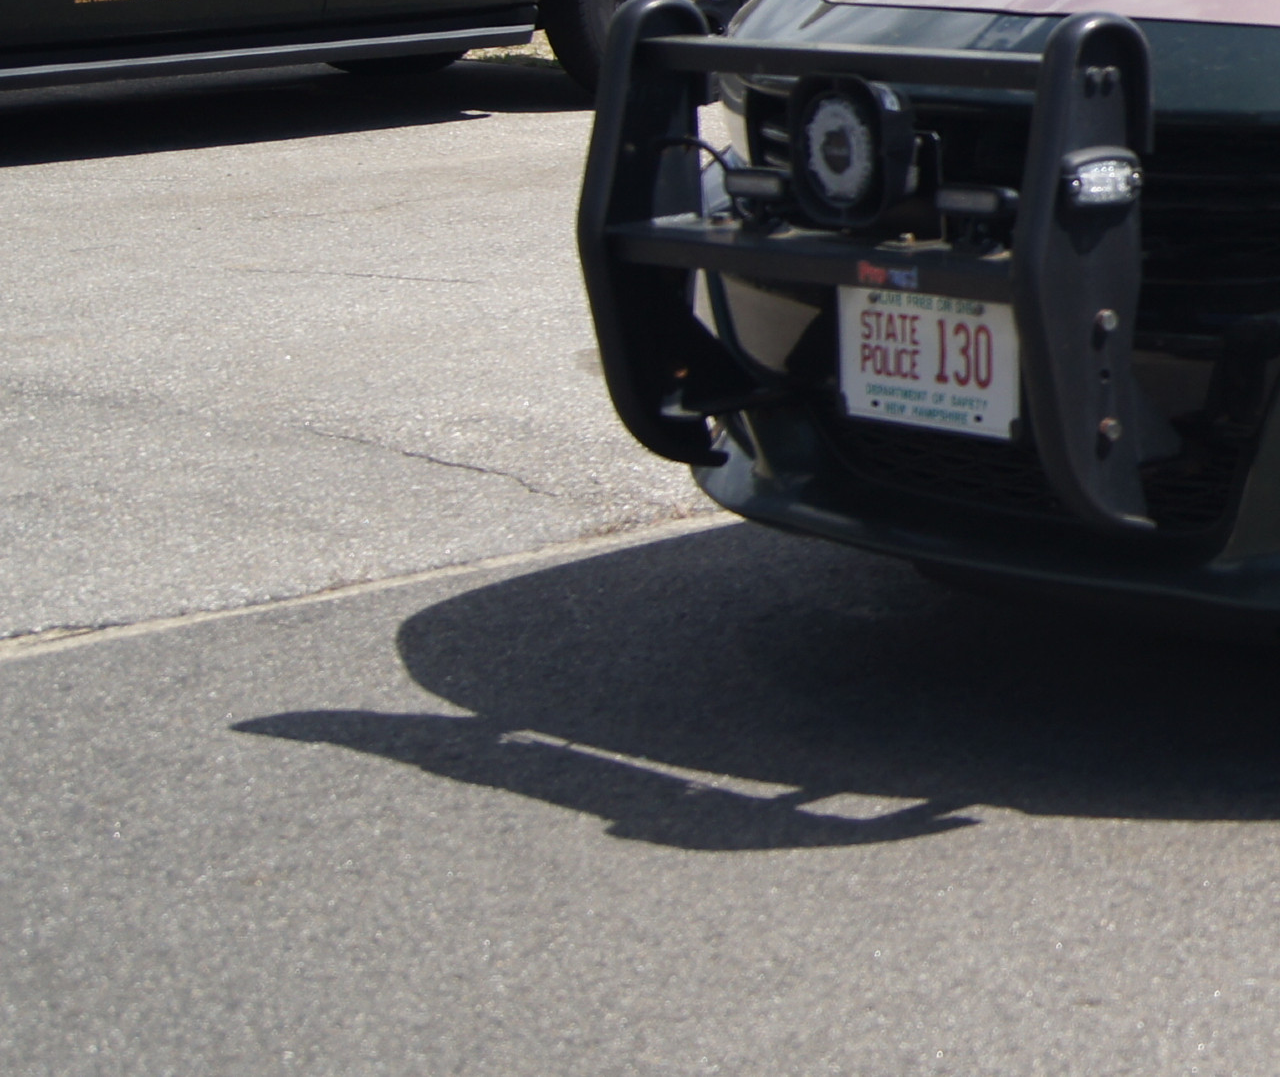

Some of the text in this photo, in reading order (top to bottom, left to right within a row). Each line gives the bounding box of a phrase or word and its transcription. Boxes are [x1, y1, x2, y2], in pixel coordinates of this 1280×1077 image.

[860, 310, 920, 345] STATE
[861, 342, 920, 380] POLICE
[935, 319, 993, 390] 130
[866, 383, 988, 410] DEPARTMENT OF SAFETY
[885, 401, 968, 423] NEW HAMPSHIRE
